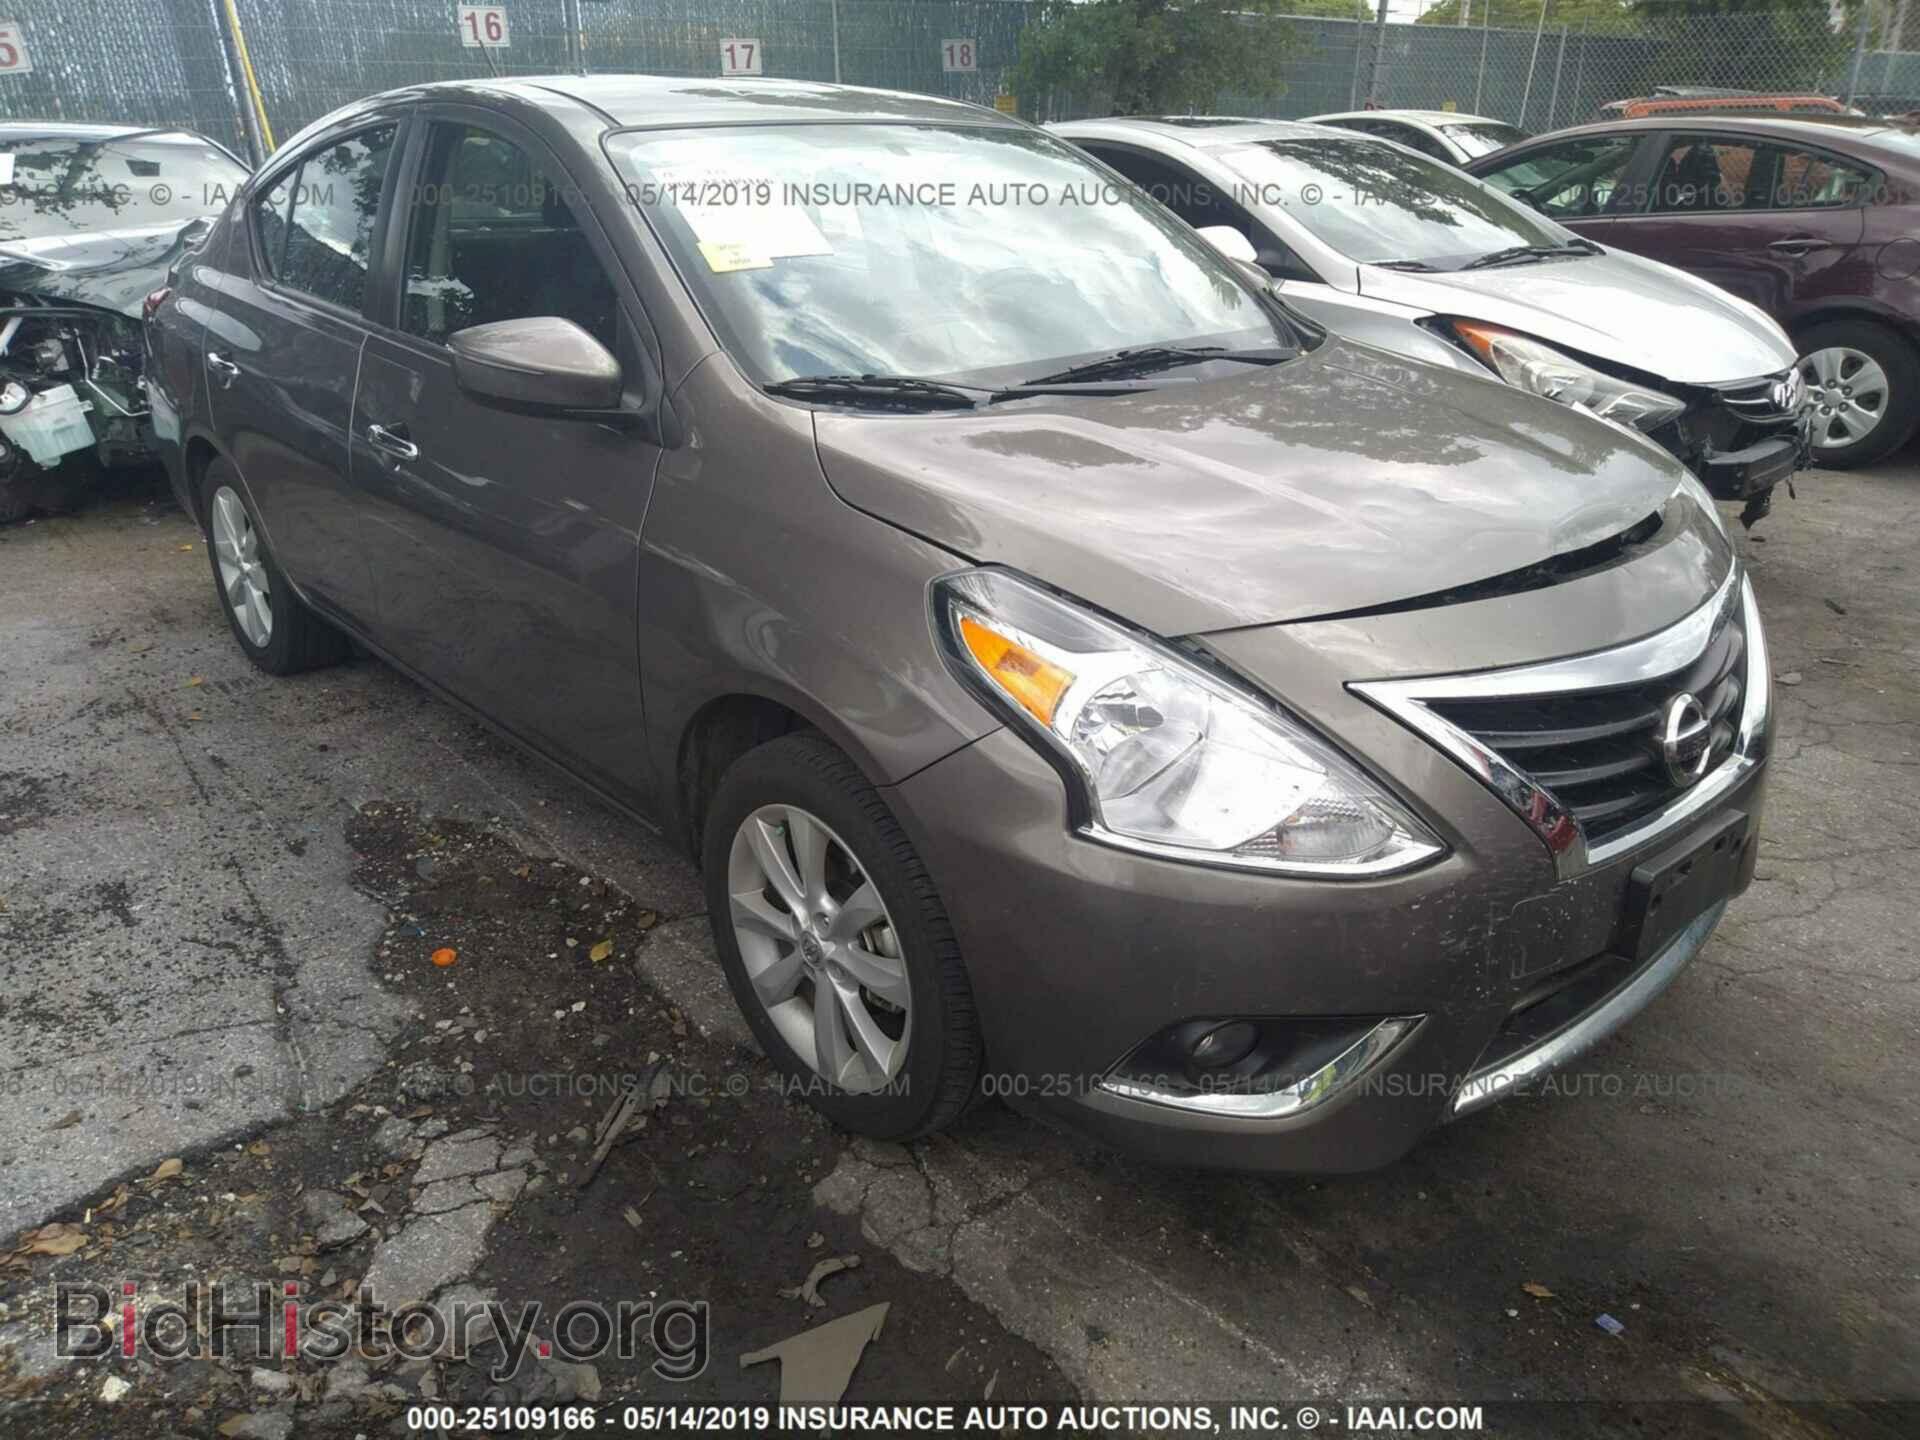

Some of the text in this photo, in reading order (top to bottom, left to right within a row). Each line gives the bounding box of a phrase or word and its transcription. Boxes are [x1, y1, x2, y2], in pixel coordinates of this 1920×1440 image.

[465, 11, 502, 41] 16
[725, 44, 754, 70] 17
[945, 44, 972, 67] 18
